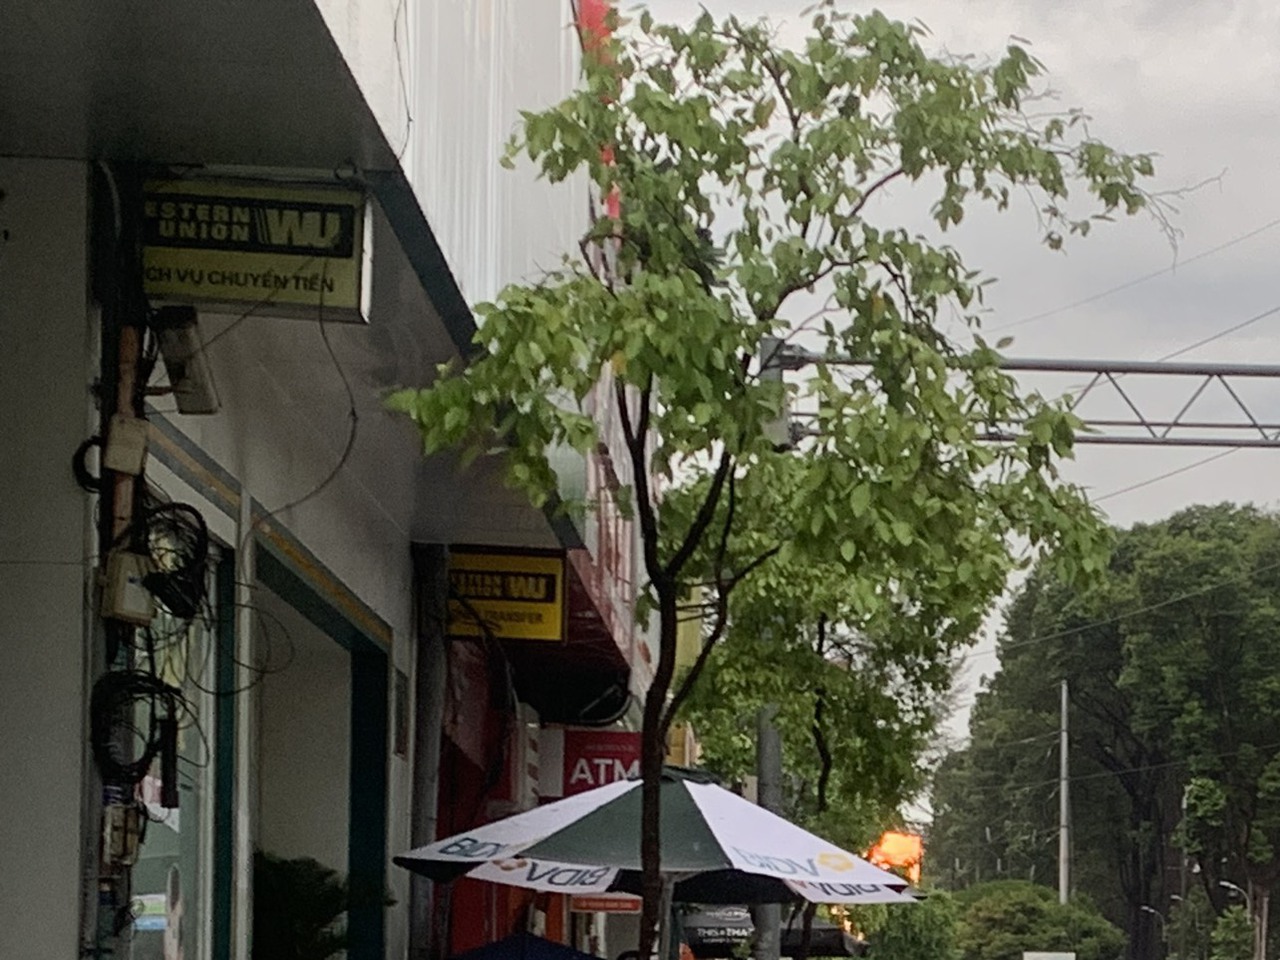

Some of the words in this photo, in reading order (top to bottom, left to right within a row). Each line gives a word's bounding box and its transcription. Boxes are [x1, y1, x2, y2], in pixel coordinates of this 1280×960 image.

[145, 201, 250, 222] ESTERN
[158, 221, 250, 242] UNION
[569, 757, 642, 785] ATM
